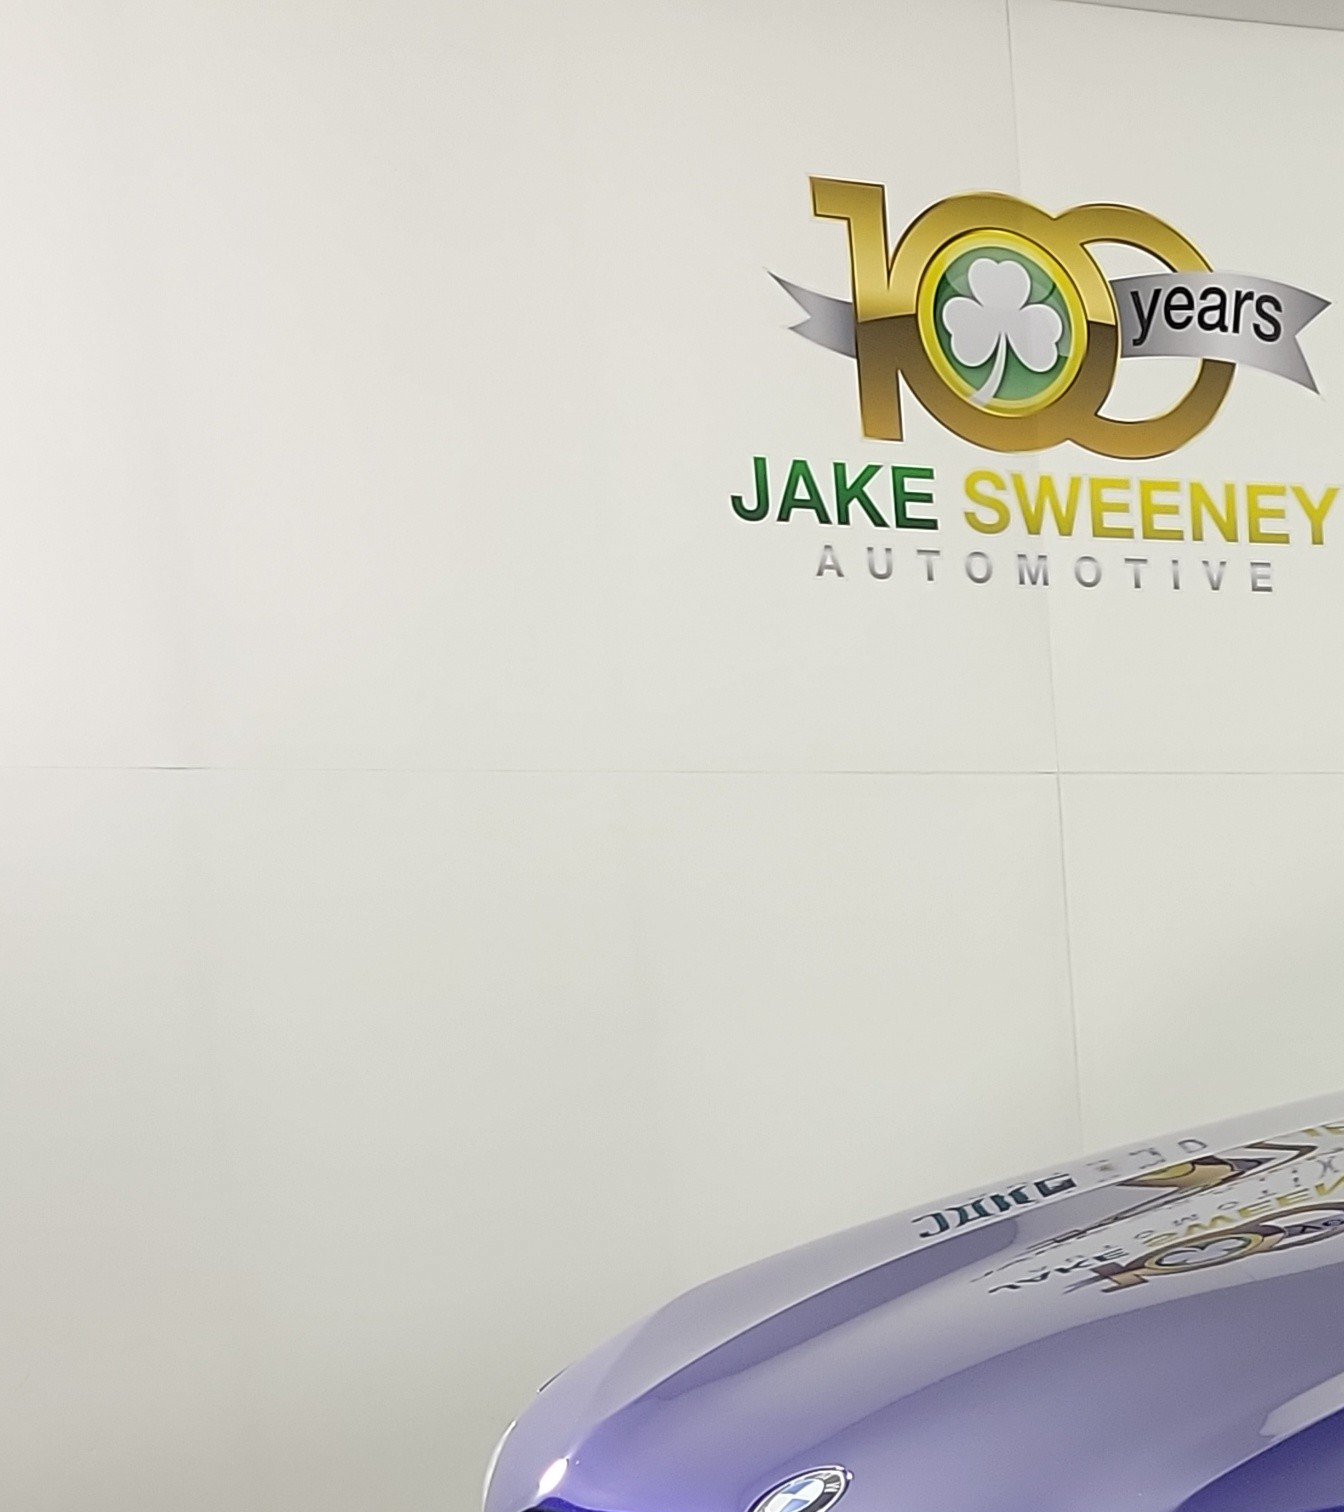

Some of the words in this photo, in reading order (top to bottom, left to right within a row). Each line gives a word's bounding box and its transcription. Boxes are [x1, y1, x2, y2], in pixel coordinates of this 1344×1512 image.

[1131, 284, 1284, 347] years
[730, 456, 940, 531] JAKE
[962, 469, 1341, 546] SWEENEY
[816, 544, 1274, 593] AUTOMOTIVE
